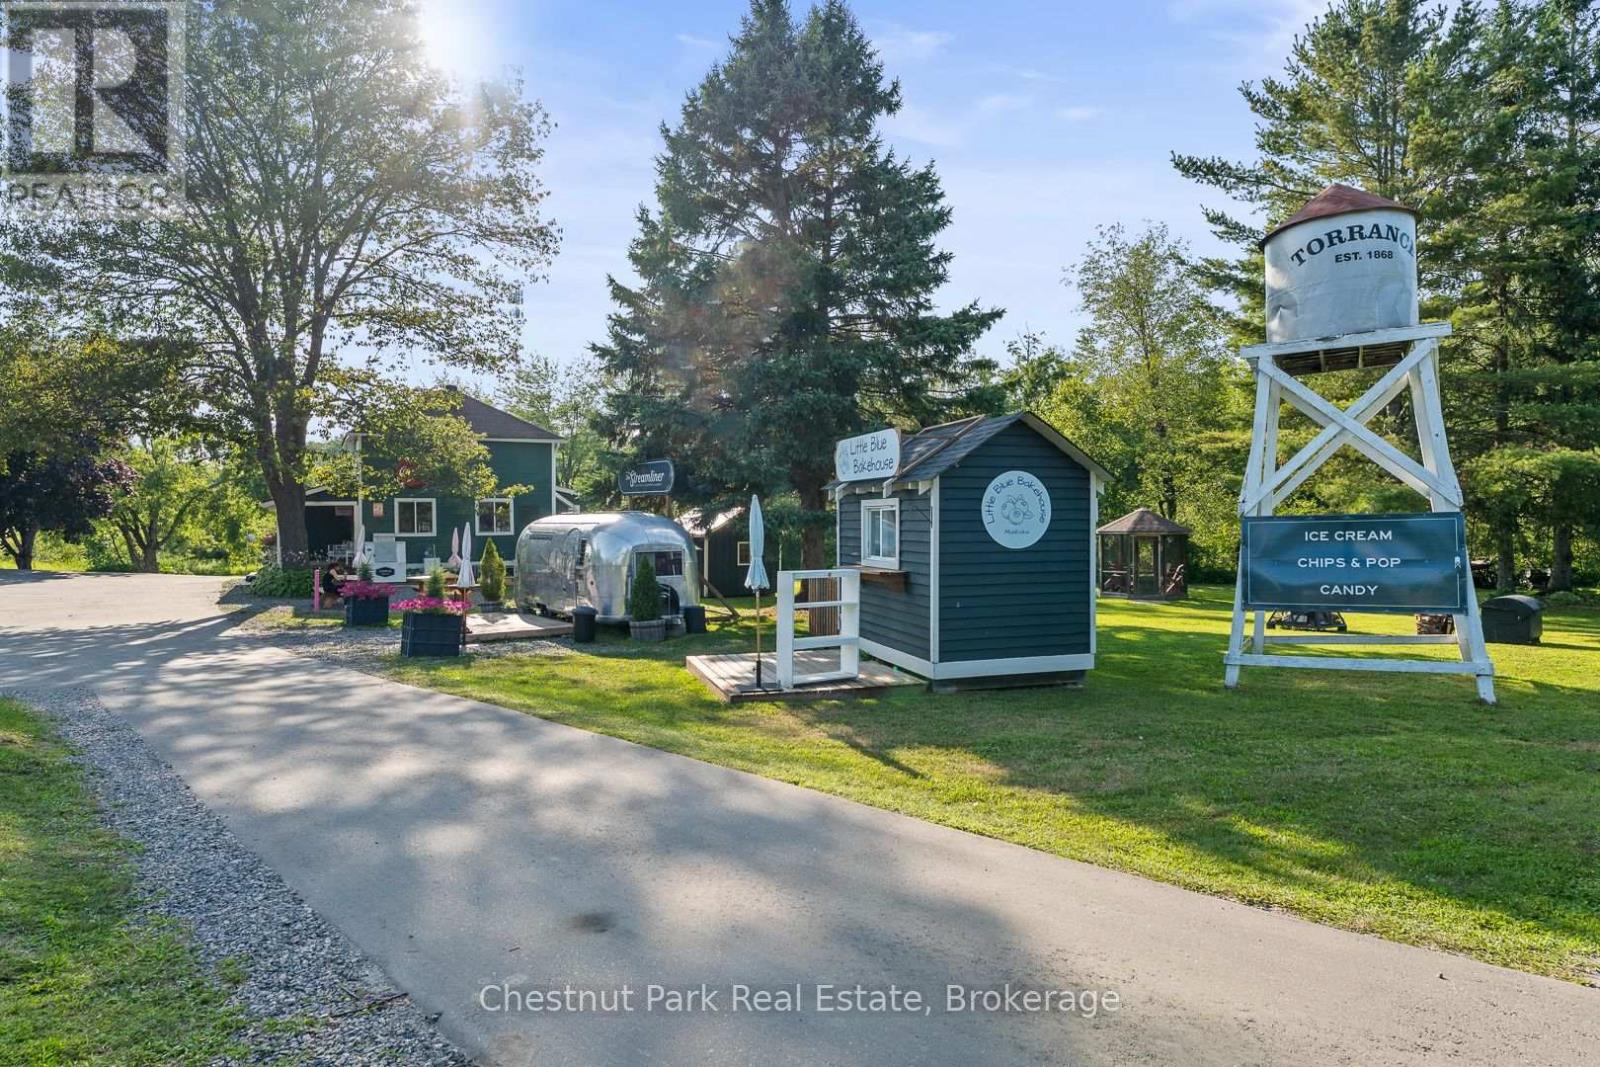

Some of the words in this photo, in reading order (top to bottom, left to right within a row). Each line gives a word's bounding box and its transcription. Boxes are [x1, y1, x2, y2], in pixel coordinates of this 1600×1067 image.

[1335, 251, 1362, 263] EST.
[1366, 250, 1393, 260] 1868
[850, 439, 868, 455] Little
[870, 435, 887, 452] Blue
[852, 456, 894, 474] Bakehouse
[984, 496, 996, 525] Little
[992, 479, 1015, 495] Blue
[1016, 475, 1047, 524] Bakehouse
[1304, 530, 1330, 542] ICE
[1334, 529, 1393, 542] CREAM
[1297, 557, 1346, 568] CHIPS
[1350, 557, 1361, 568] &
[1366, 557, 1401, 568] POP
[1319, 584, 1379, 596] CANDY
